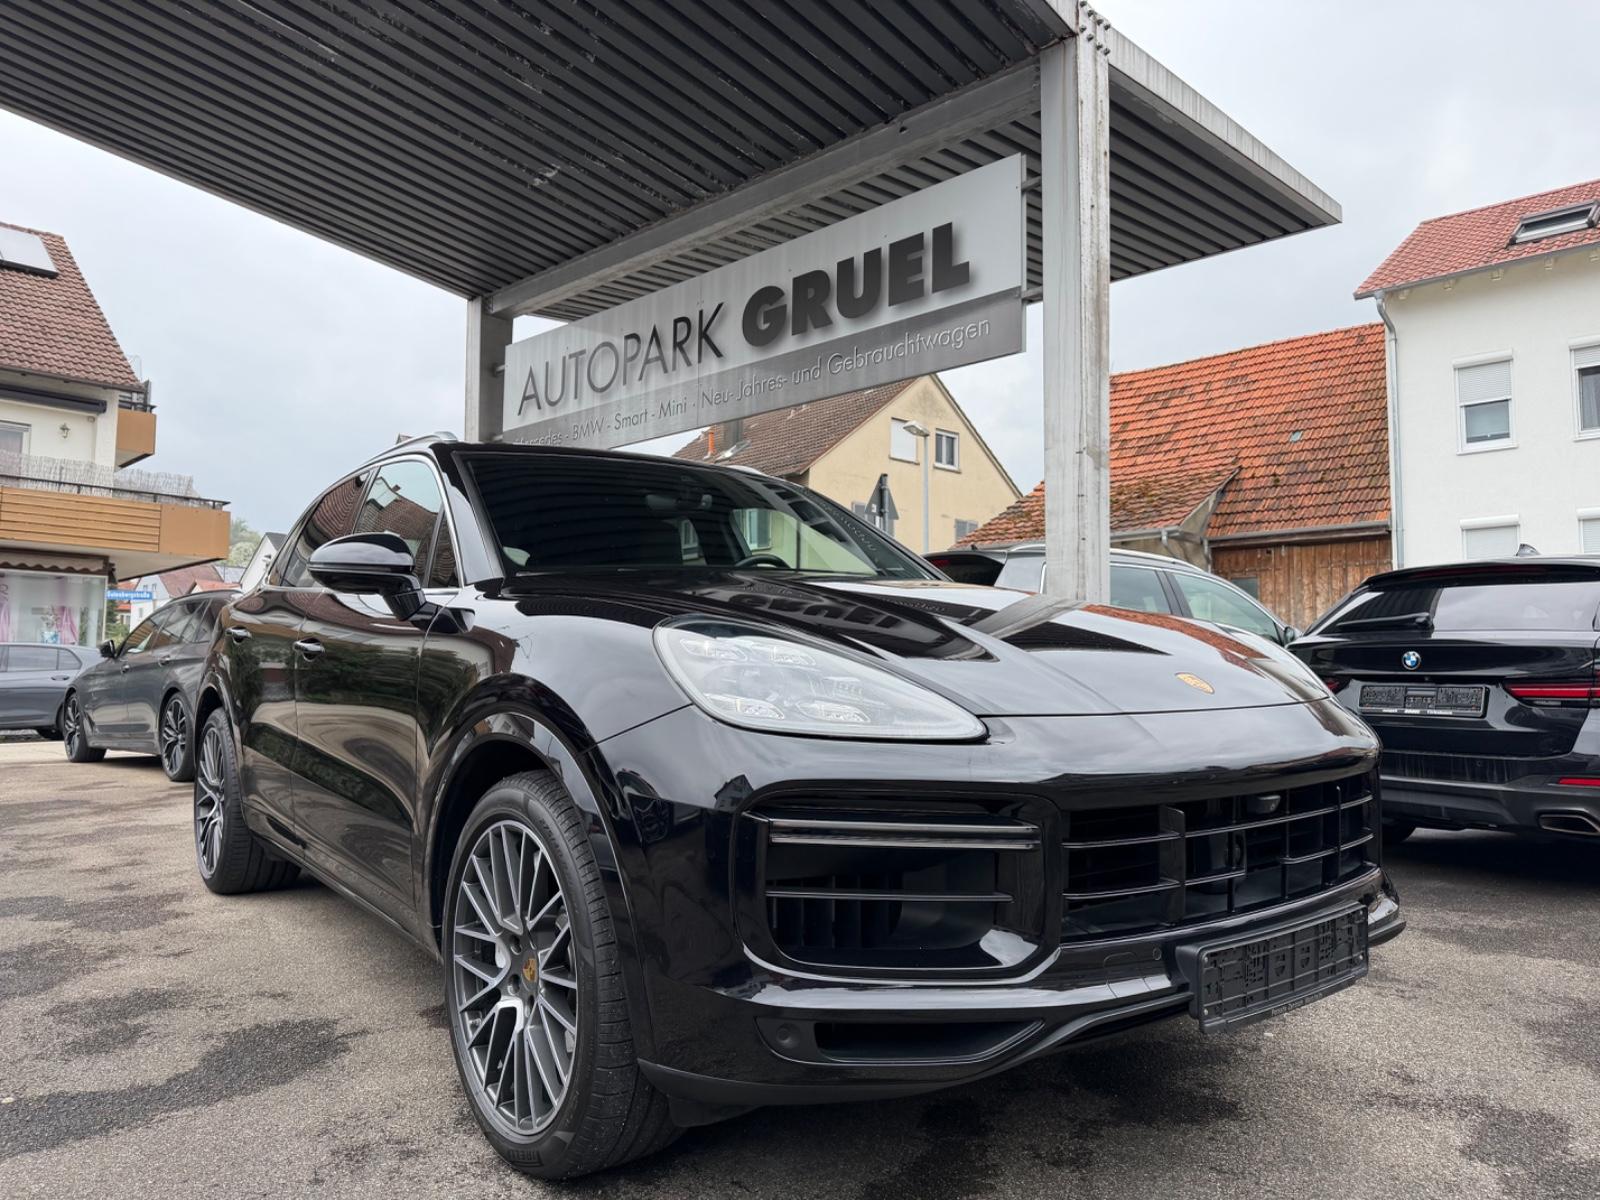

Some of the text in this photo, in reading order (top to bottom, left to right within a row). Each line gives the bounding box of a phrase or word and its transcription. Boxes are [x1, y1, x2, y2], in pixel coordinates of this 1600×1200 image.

[517, 222, 970, 416] AUTOPARK GRUEL
[572, 419, 605, 440] BMW
[614, 411, 648, 431] Smart
[658, 397, 687, 419] Mini
[791, 356, 821, 384] und
[827, 318, 990, 375] Gebrauchtwagen
